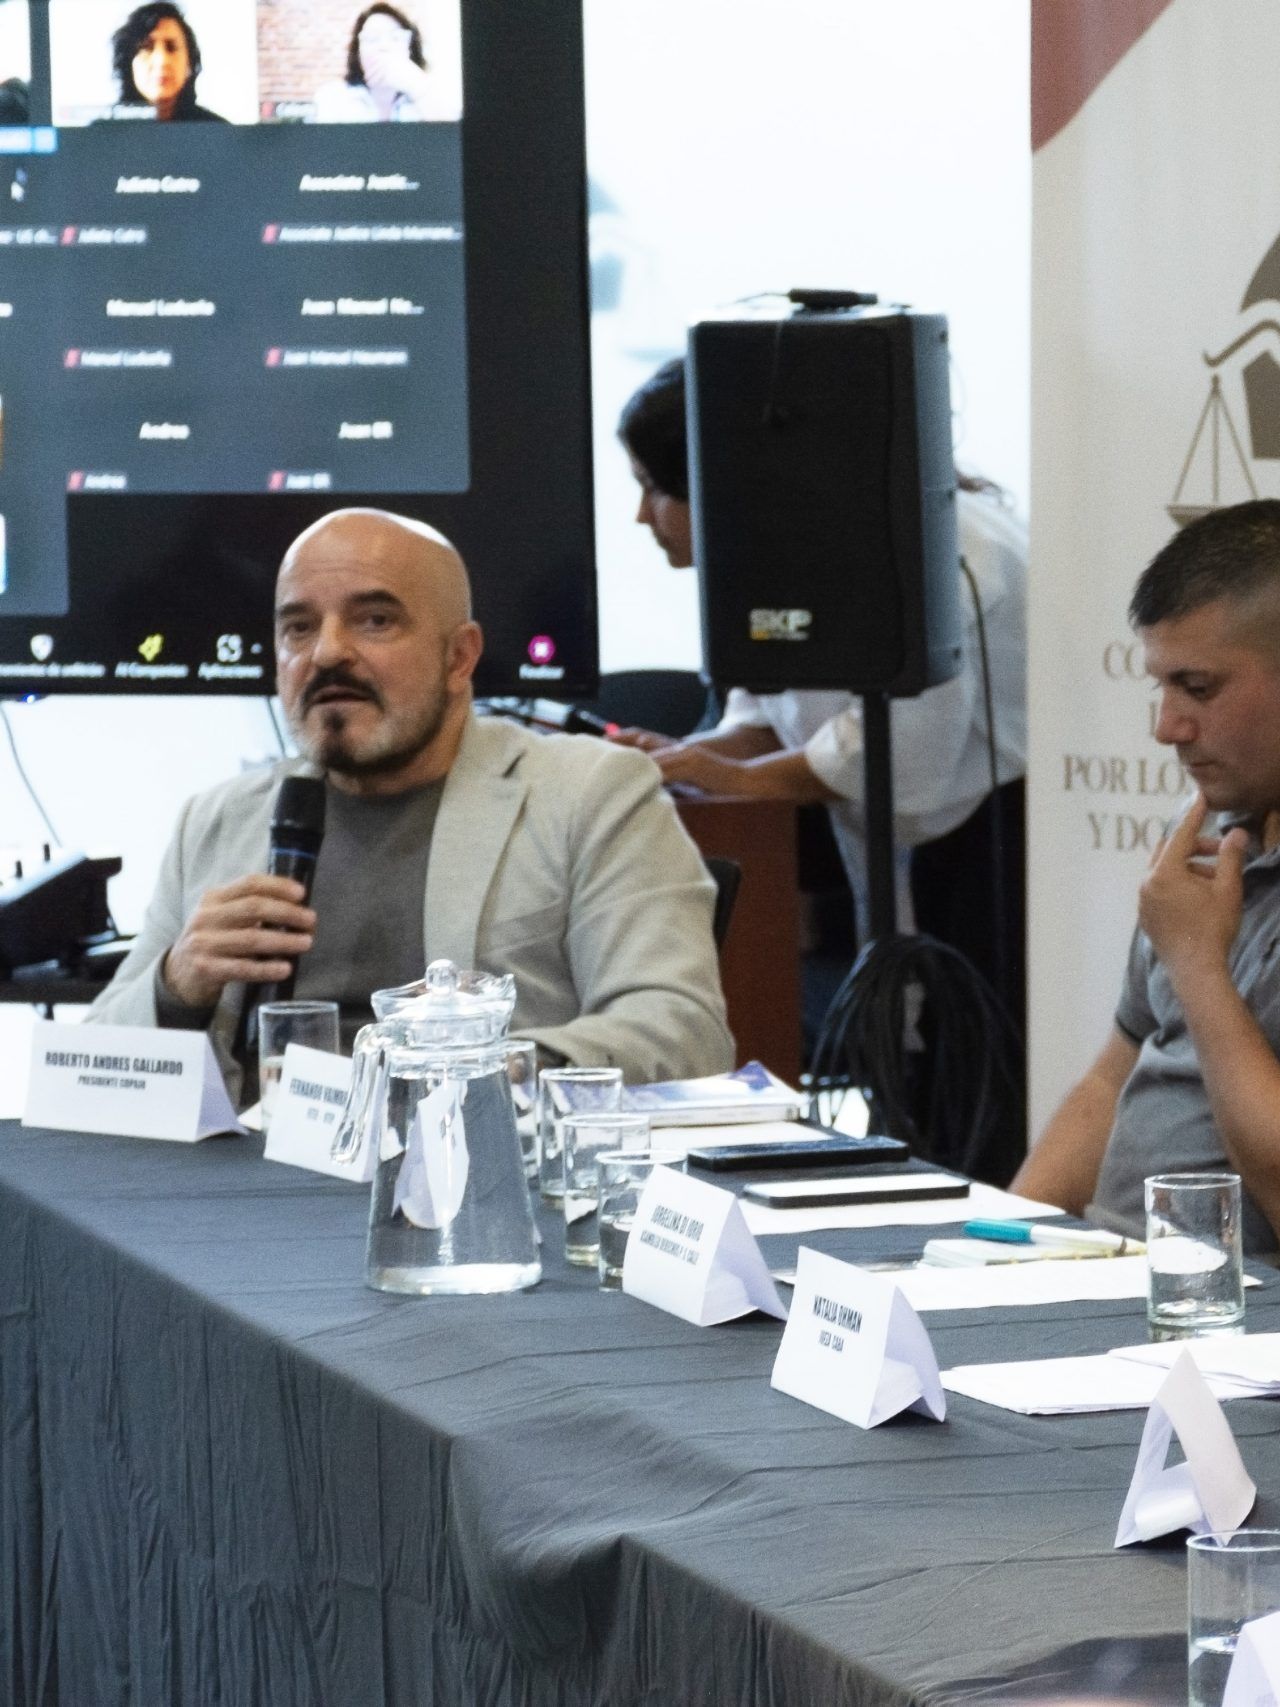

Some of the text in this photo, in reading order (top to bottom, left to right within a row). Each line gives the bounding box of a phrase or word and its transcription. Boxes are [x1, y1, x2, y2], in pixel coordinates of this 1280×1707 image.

[45, 1052, 183, 1076] ROBERTO ANDRES GALLARDO
[813, 1294, 838, 1324] NATALIA
